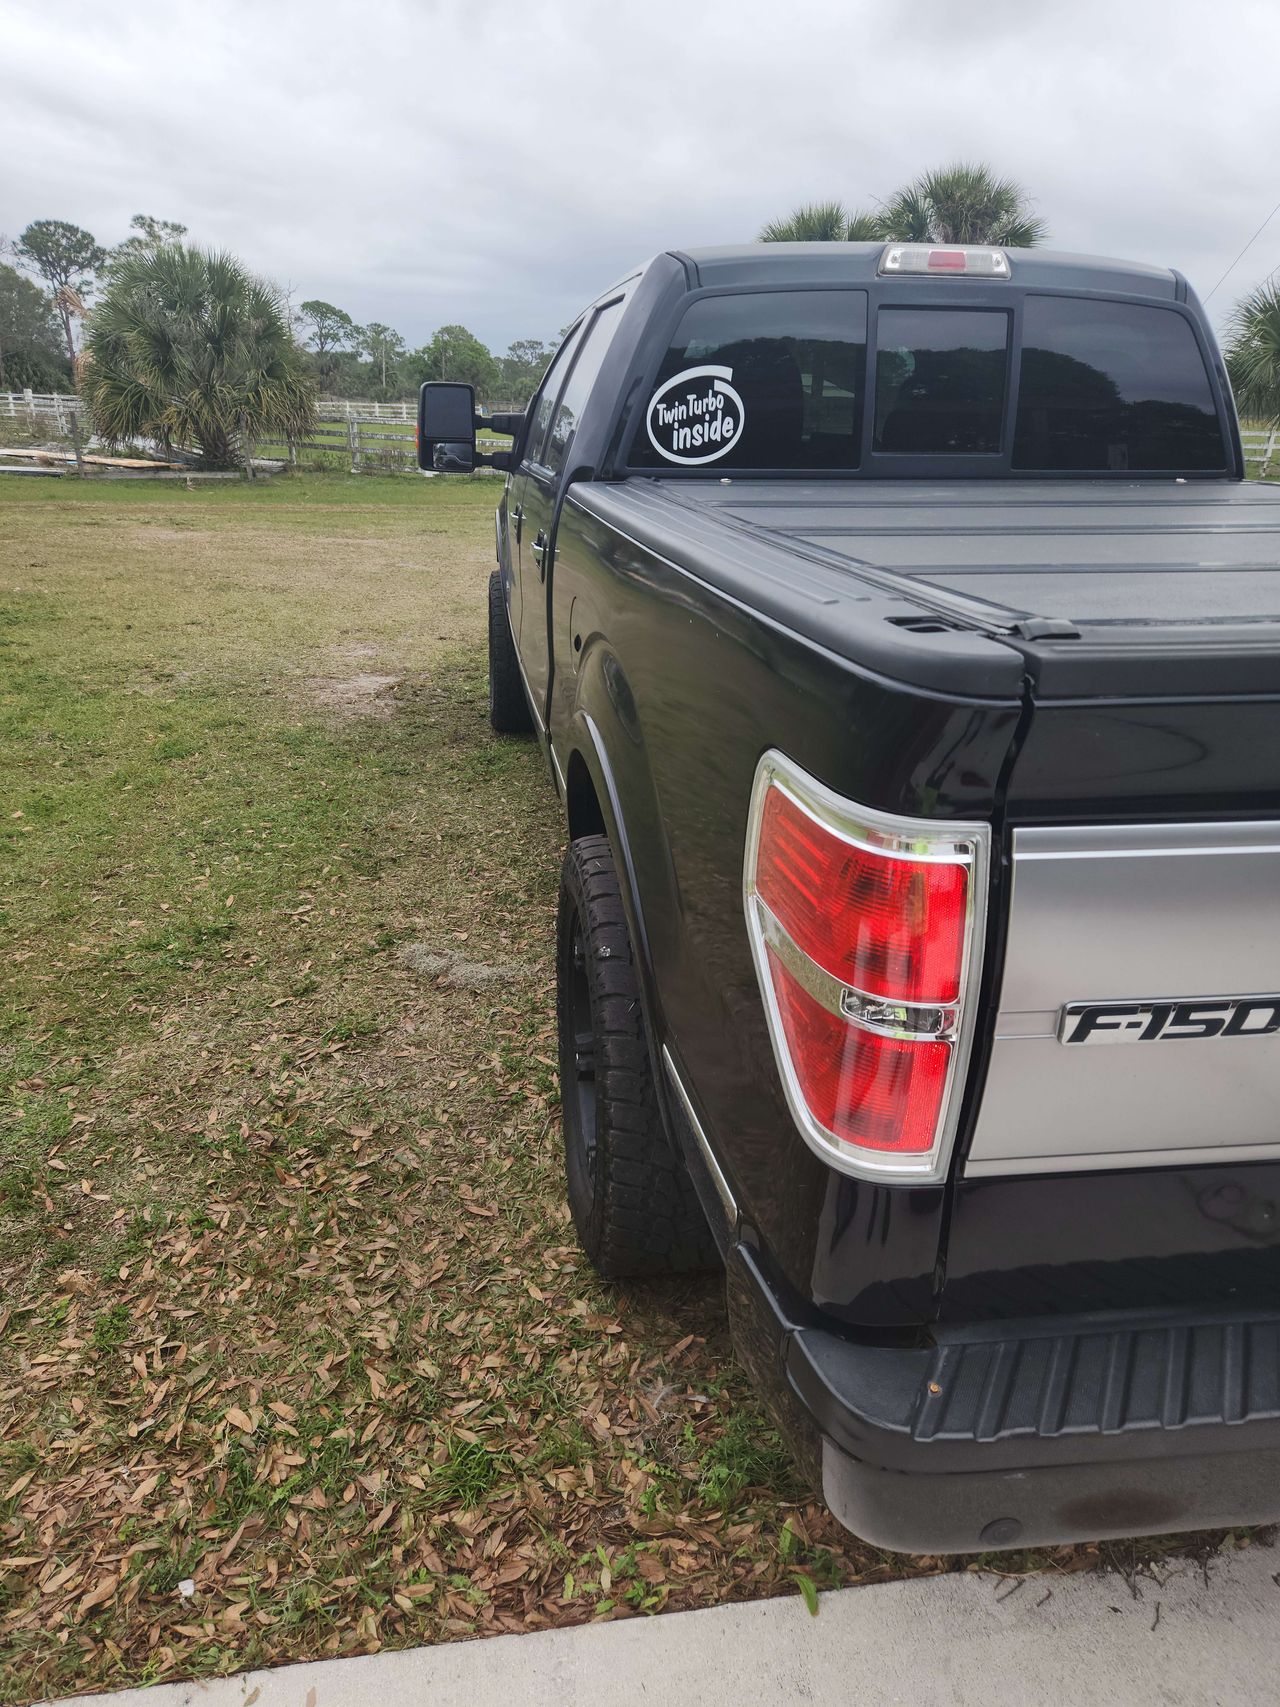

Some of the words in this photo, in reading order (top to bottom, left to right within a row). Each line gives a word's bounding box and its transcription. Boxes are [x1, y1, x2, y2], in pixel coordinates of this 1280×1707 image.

[656, 401, 687, 426] Twin
[686, 389, 725, 416] Turbo
[672, 409, 734, 451] inside
[1066, 1000, 1280, 1043] F-150
